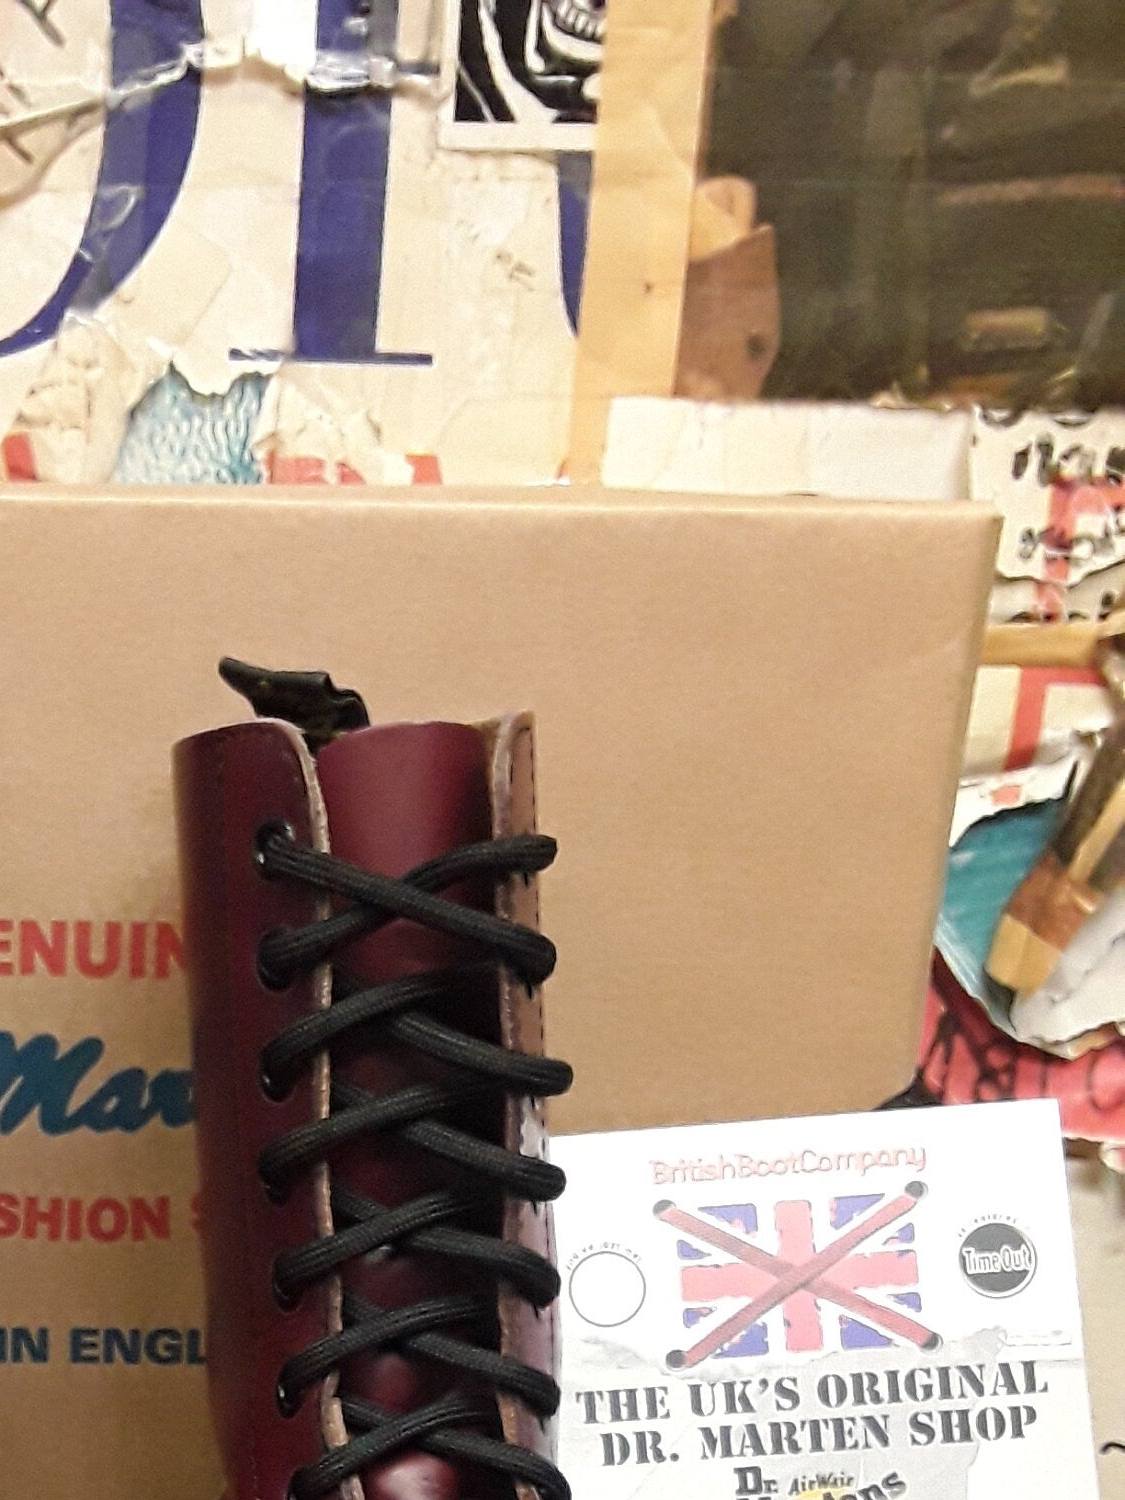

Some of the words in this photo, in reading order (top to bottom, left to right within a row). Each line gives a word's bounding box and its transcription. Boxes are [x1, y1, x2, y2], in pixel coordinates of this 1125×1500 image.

[575, 1385, 671, 1424] THE
[687, 1375, 801, 1417] UK'S
[817, 1360, 1049, 1408] ORIGINAL
[600, 1429, 680, 1467] DR.
[697, 1413, 891, 1461] MARTEN
[908, 1404, 1038, 1447] SHOP
